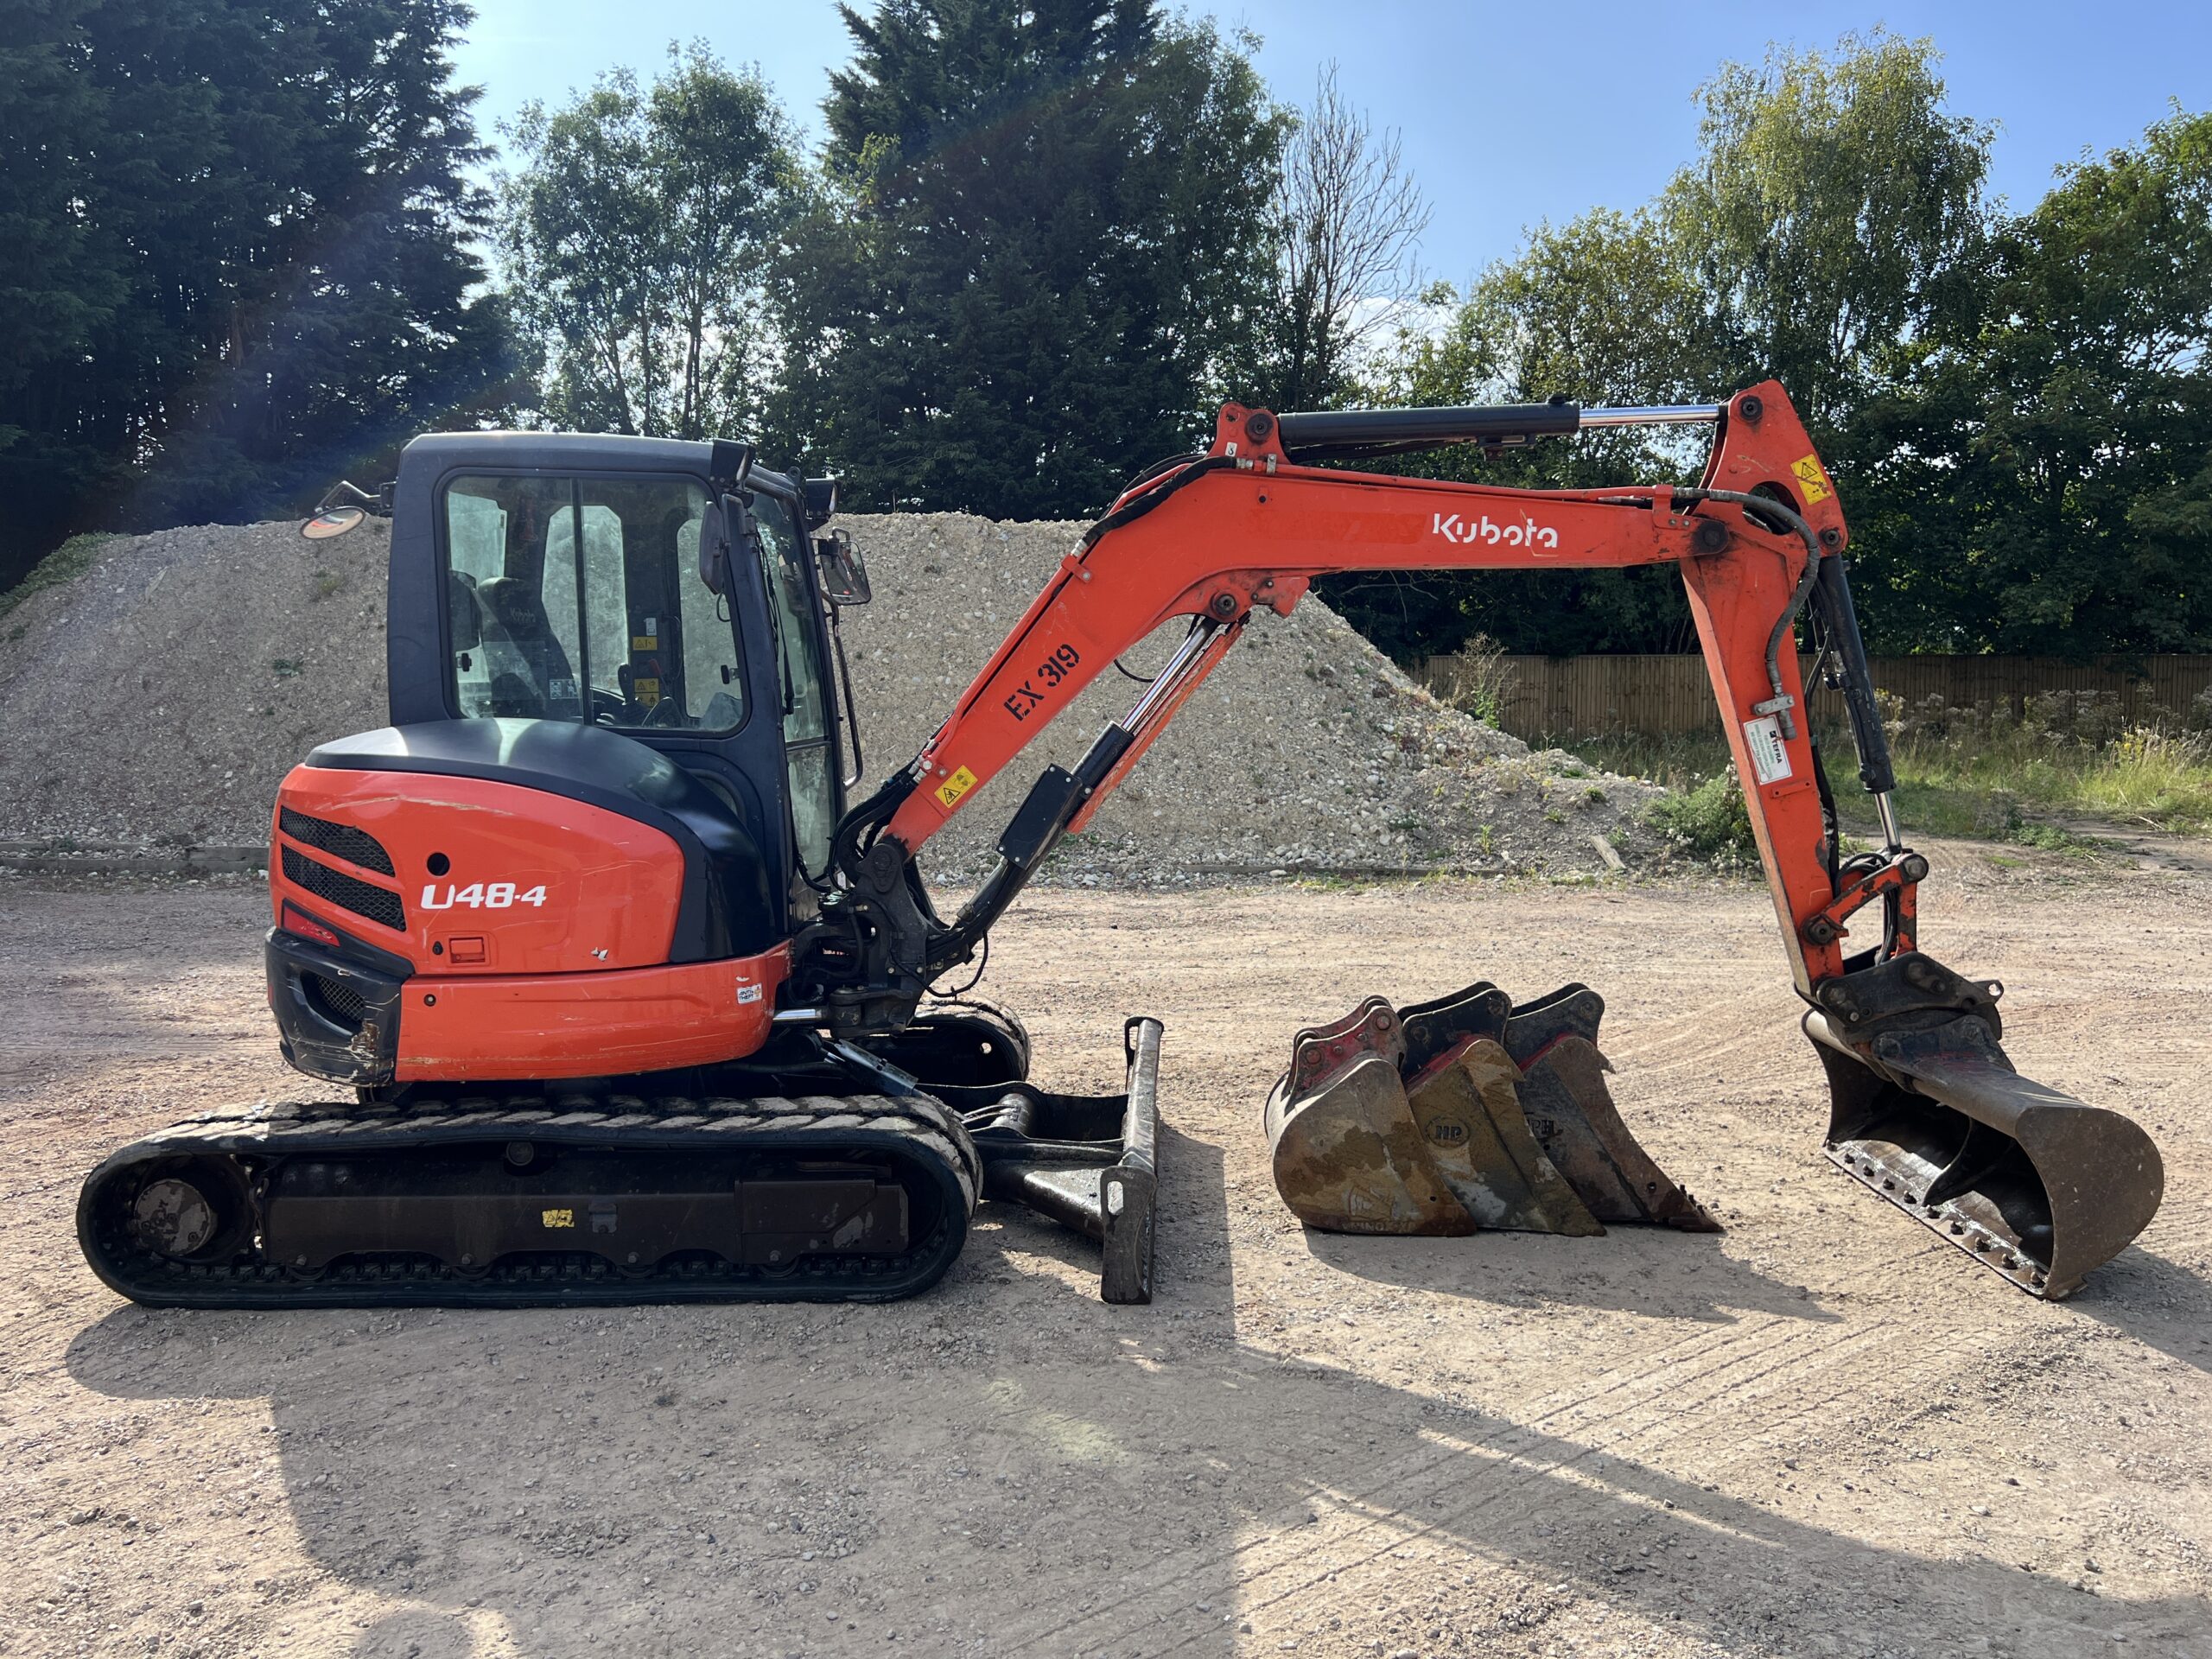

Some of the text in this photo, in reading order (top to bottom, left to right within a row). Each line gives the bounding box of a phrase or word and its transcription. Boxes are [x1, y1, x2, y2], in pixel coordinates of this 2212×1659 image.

[1433, 512, 1559, 549] Kubota
[1004, 644, 1079, 721] EX 319
[421, 883, 547, 909] U48-4
